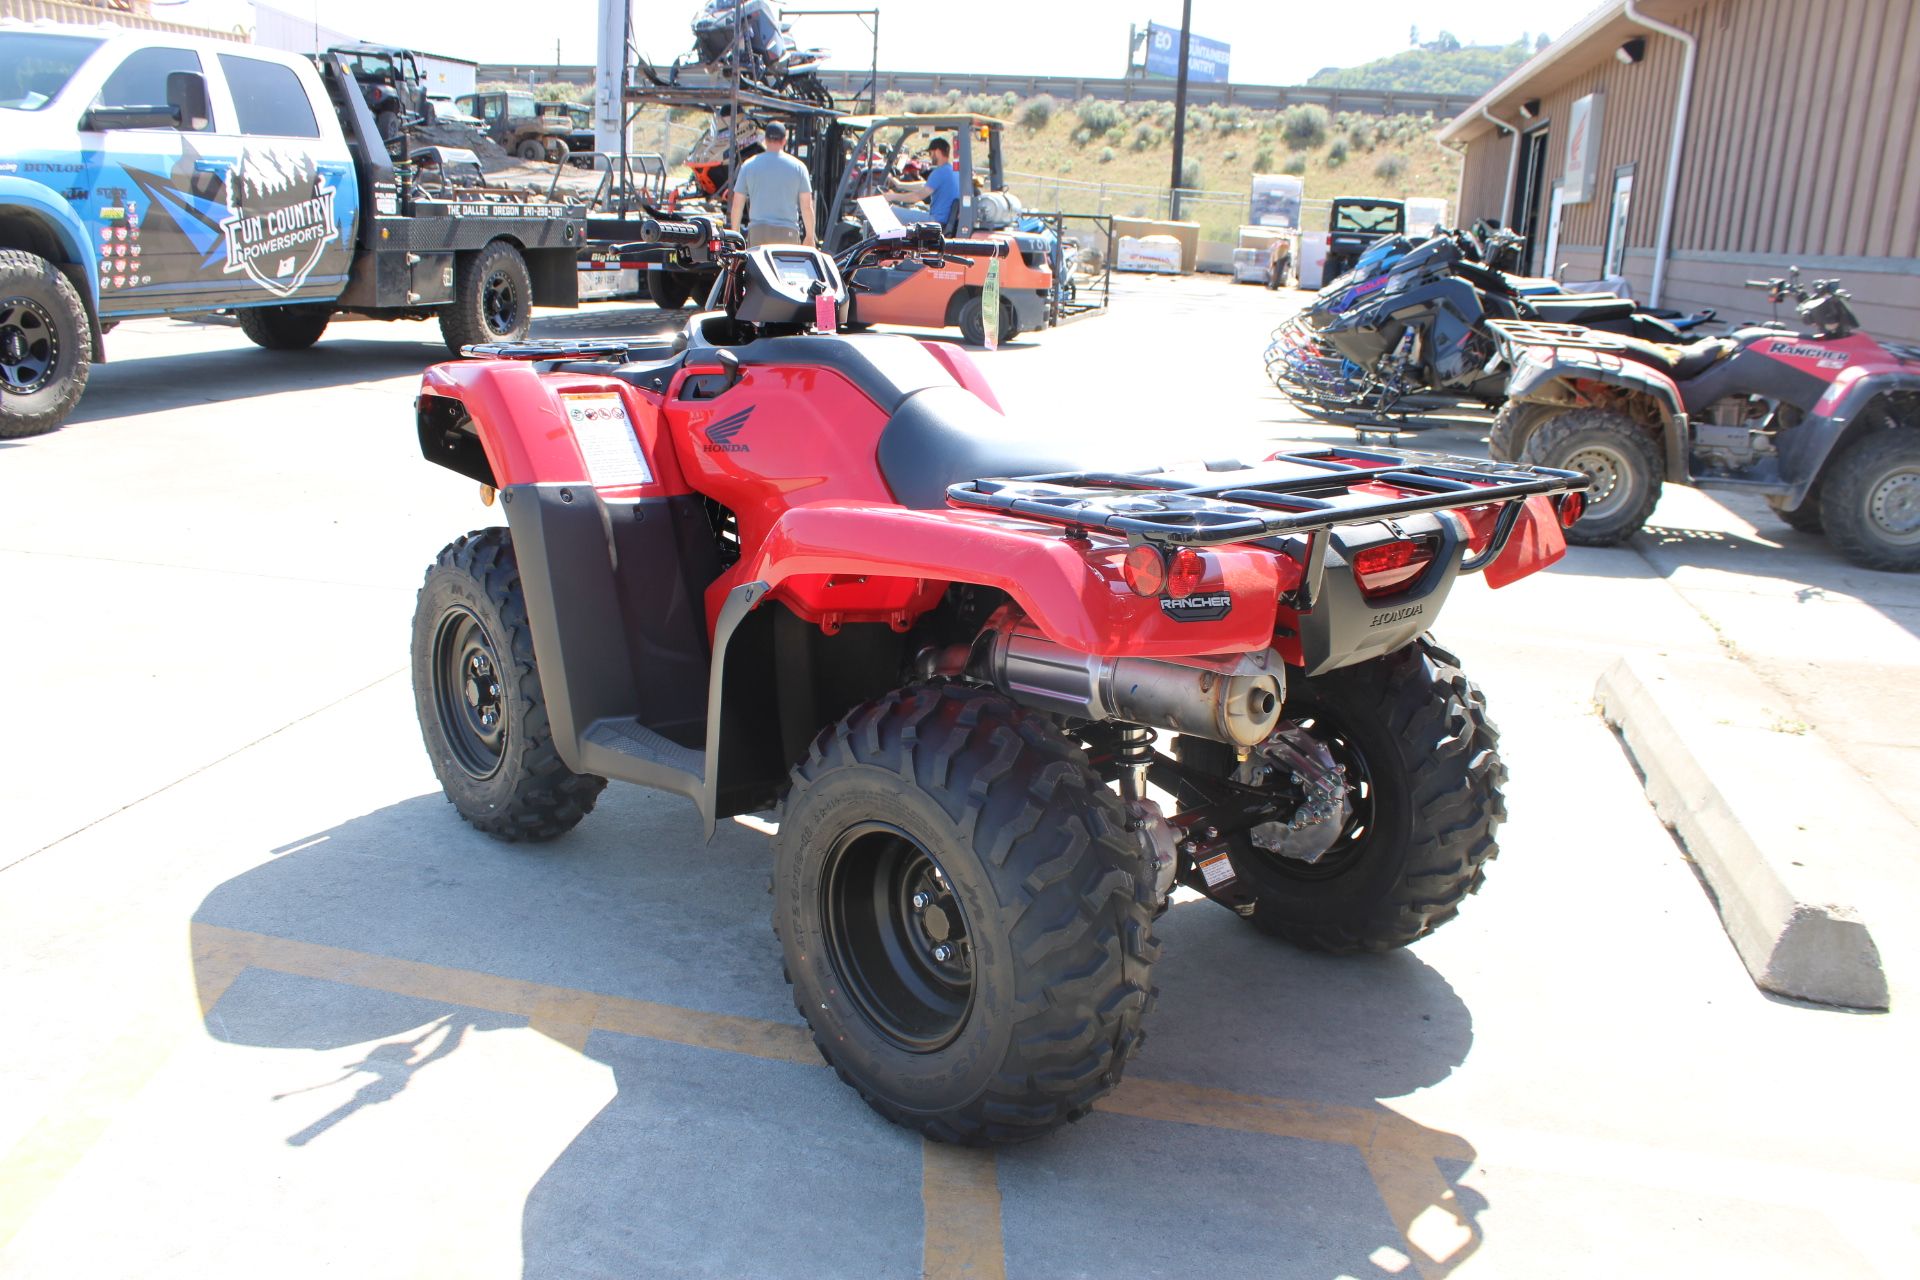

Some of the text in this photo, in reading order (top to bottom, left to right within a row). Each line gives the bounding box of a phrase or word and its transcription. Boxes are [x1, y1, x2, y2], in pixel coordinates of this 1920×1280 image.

[24, 163, 84, 173] DUNLOP
[447, 204, 460, 215] THE
[463, 204, 488, 215] DALLES
[493, 205, 519, 216] OREGON
[229, 194, 332, 265] FUN COUNTRY
[244, 224, 325, 260] POWERSPORTS
[1768, 342, 1849, 361] RANCHER
[704, 444, 750, 453] HONDA
[1160, 596, 1231, 609] RANCHER
[1369, 603, 1423, 627] HONDA
